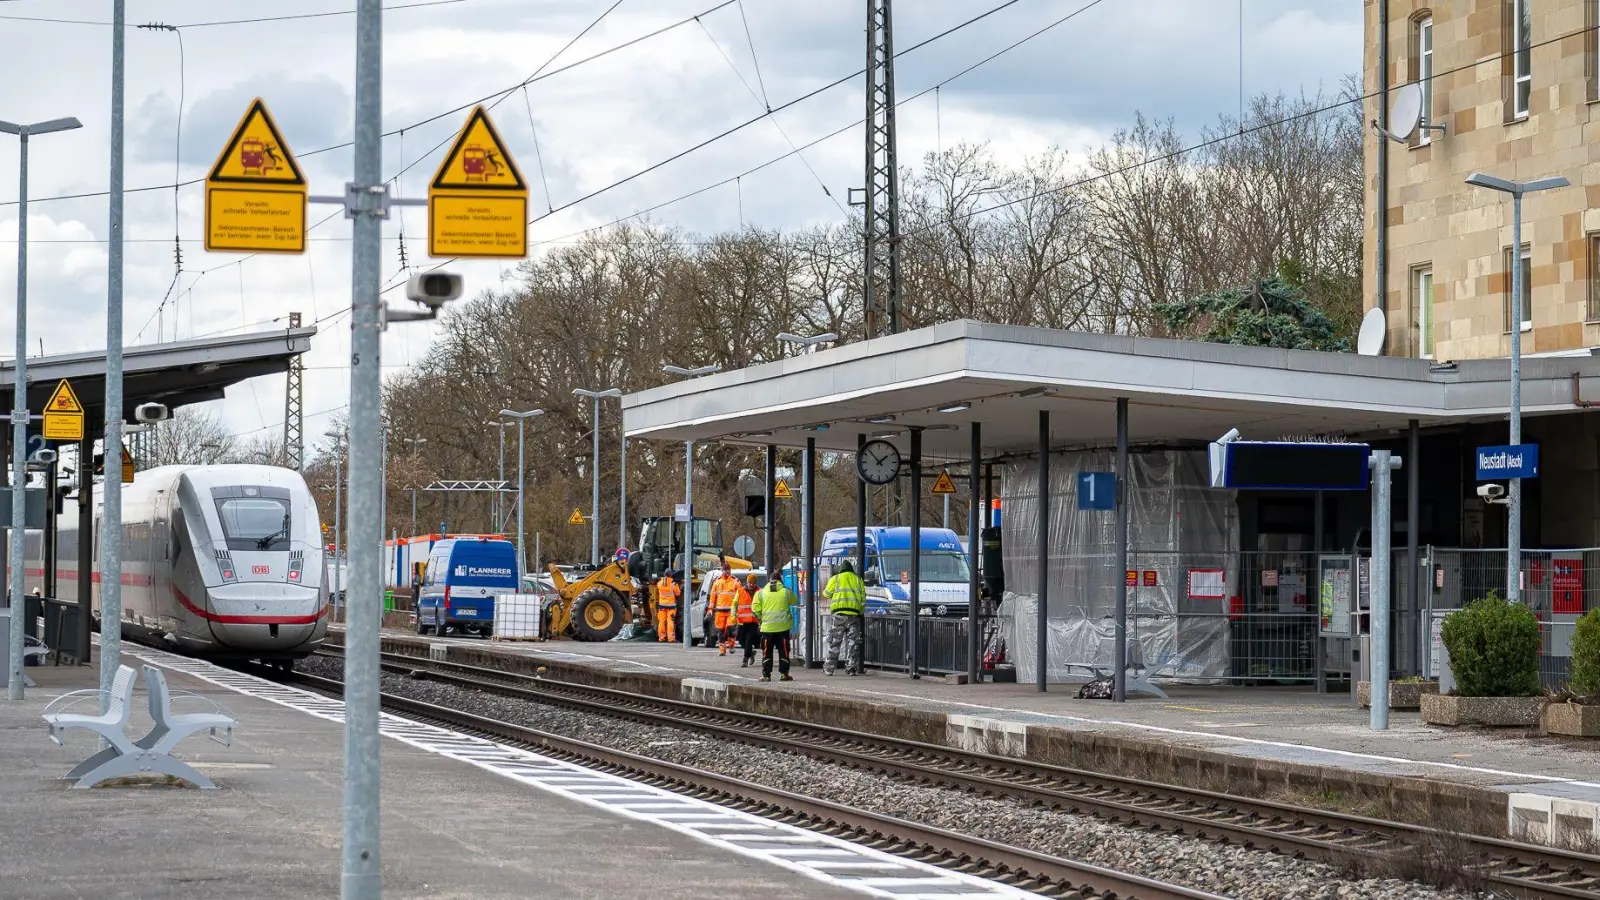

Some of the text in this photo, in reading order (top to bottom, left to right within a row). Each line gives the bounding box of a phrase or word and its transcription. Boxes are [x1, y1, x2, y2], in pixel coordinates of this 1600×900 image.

[354, 353, 360, 366] 5
[1479, 452, 1523, 470] Neustadt (Aisch)
[1084, 473, 1095, 502] 1
[252, 566, 269, 574] DB
